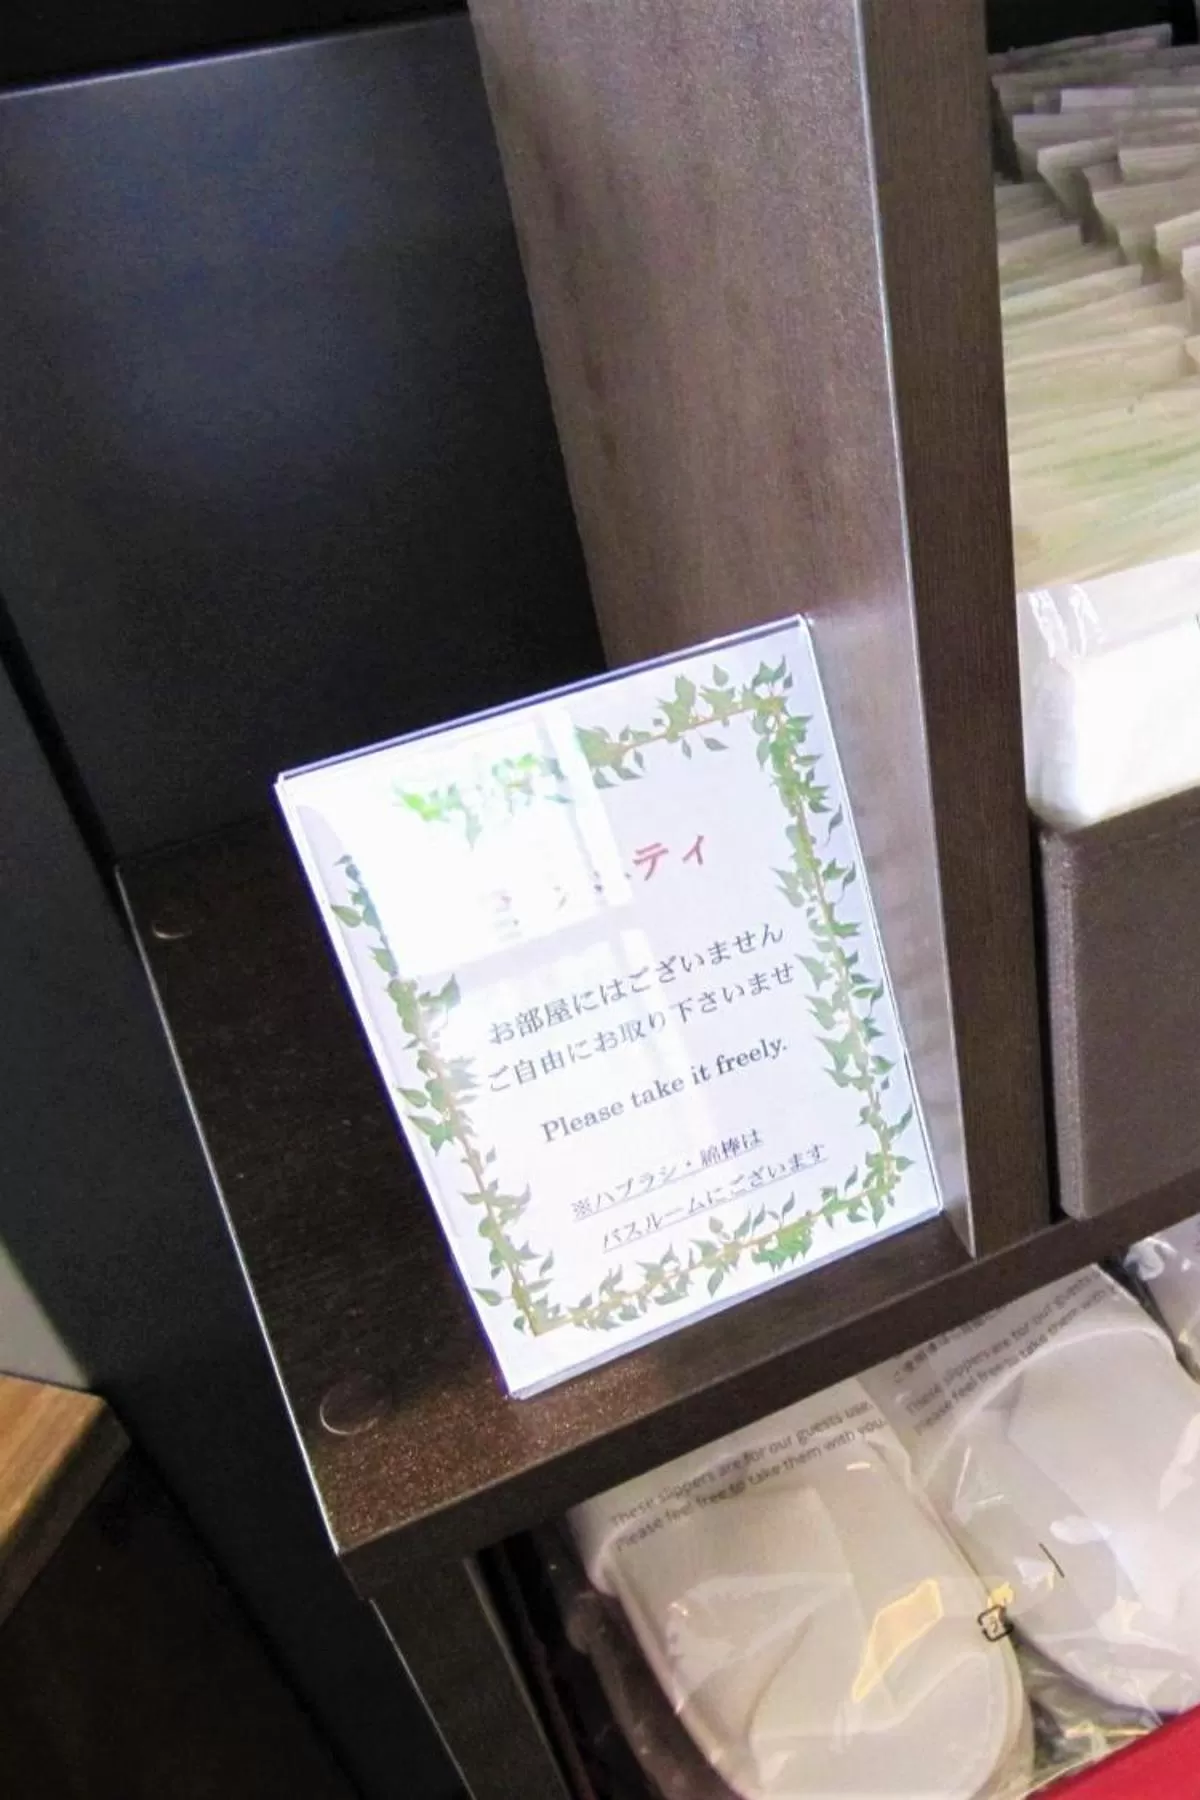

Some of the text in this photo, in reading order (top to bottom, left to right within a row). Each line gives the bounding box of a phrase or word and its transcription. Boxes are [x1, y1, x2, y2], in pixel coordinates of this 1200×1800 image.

[487, 962, 795, 1093] ご自由にお取り下さいませ
[488, 922, 784, 1046] お部屋にはございません
[540, 1036, 788, 1144] Please take it freely.
[602, 1143, 825, 1249] バスルームにございます
